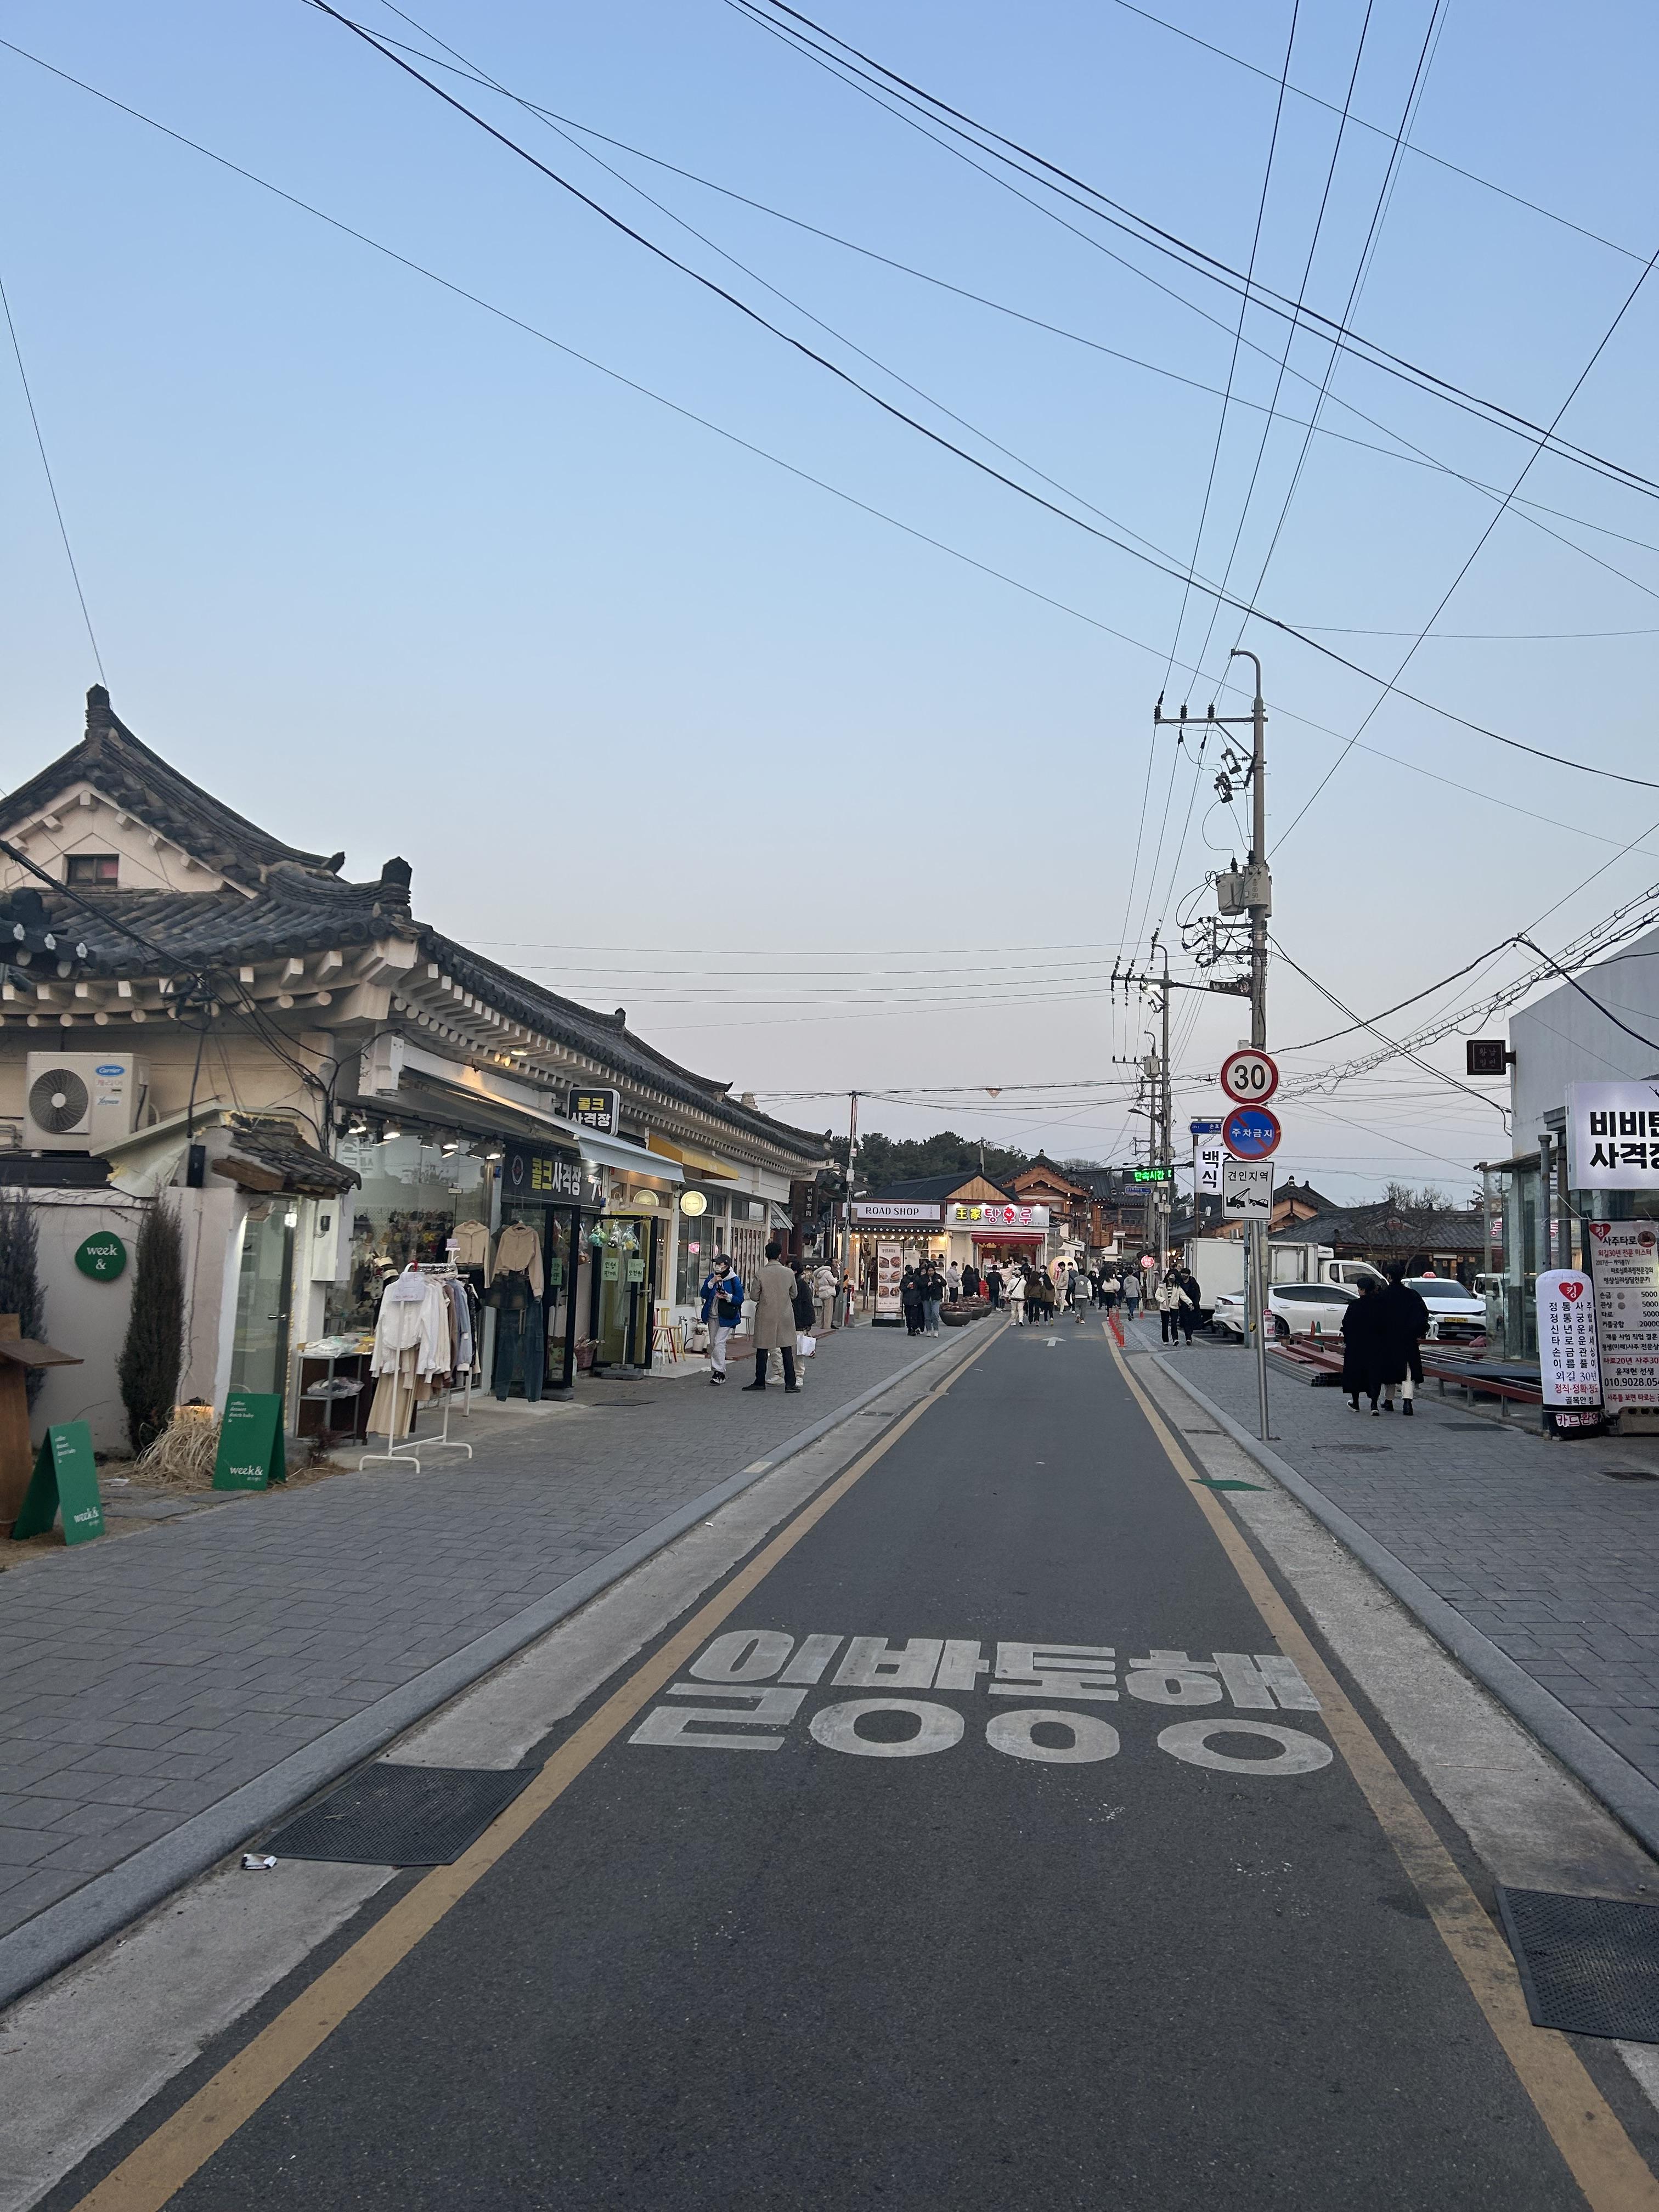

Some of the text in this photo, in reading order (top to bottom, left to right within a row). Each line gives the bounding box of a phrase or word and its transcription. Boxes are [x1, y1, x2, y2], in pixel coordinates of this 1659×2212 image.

[1234, 1064, 1265, 1090] 30
[578, 1097, 604, 1111] 콜크
[571, 1113, 611, 1127] 사격장
[1232, 1128, 1272, 1138] 주차금지
[532, 1158, 582, 1195] 콜크사격장
[1201, 1170, 1217, 1188] 식
[1228, 1171, 1268, 1181] 견인지역
[866, 1206, 891, 1215] ROAD
[1595, 1227, 1604, 1237] 킹
[1602, 1236, 1638, 1246] 사주타로
[87, 1244, 118, 1255] week
[95, 1259, 106, 1269] &
[1566, 1285, 1576, 1298] 킹
[1604, 1378, 1659, 1387] 010.9028.05
[230, 1465, 263, 1475] week&
[627, 1629, 1334, 1775] 일방통행
